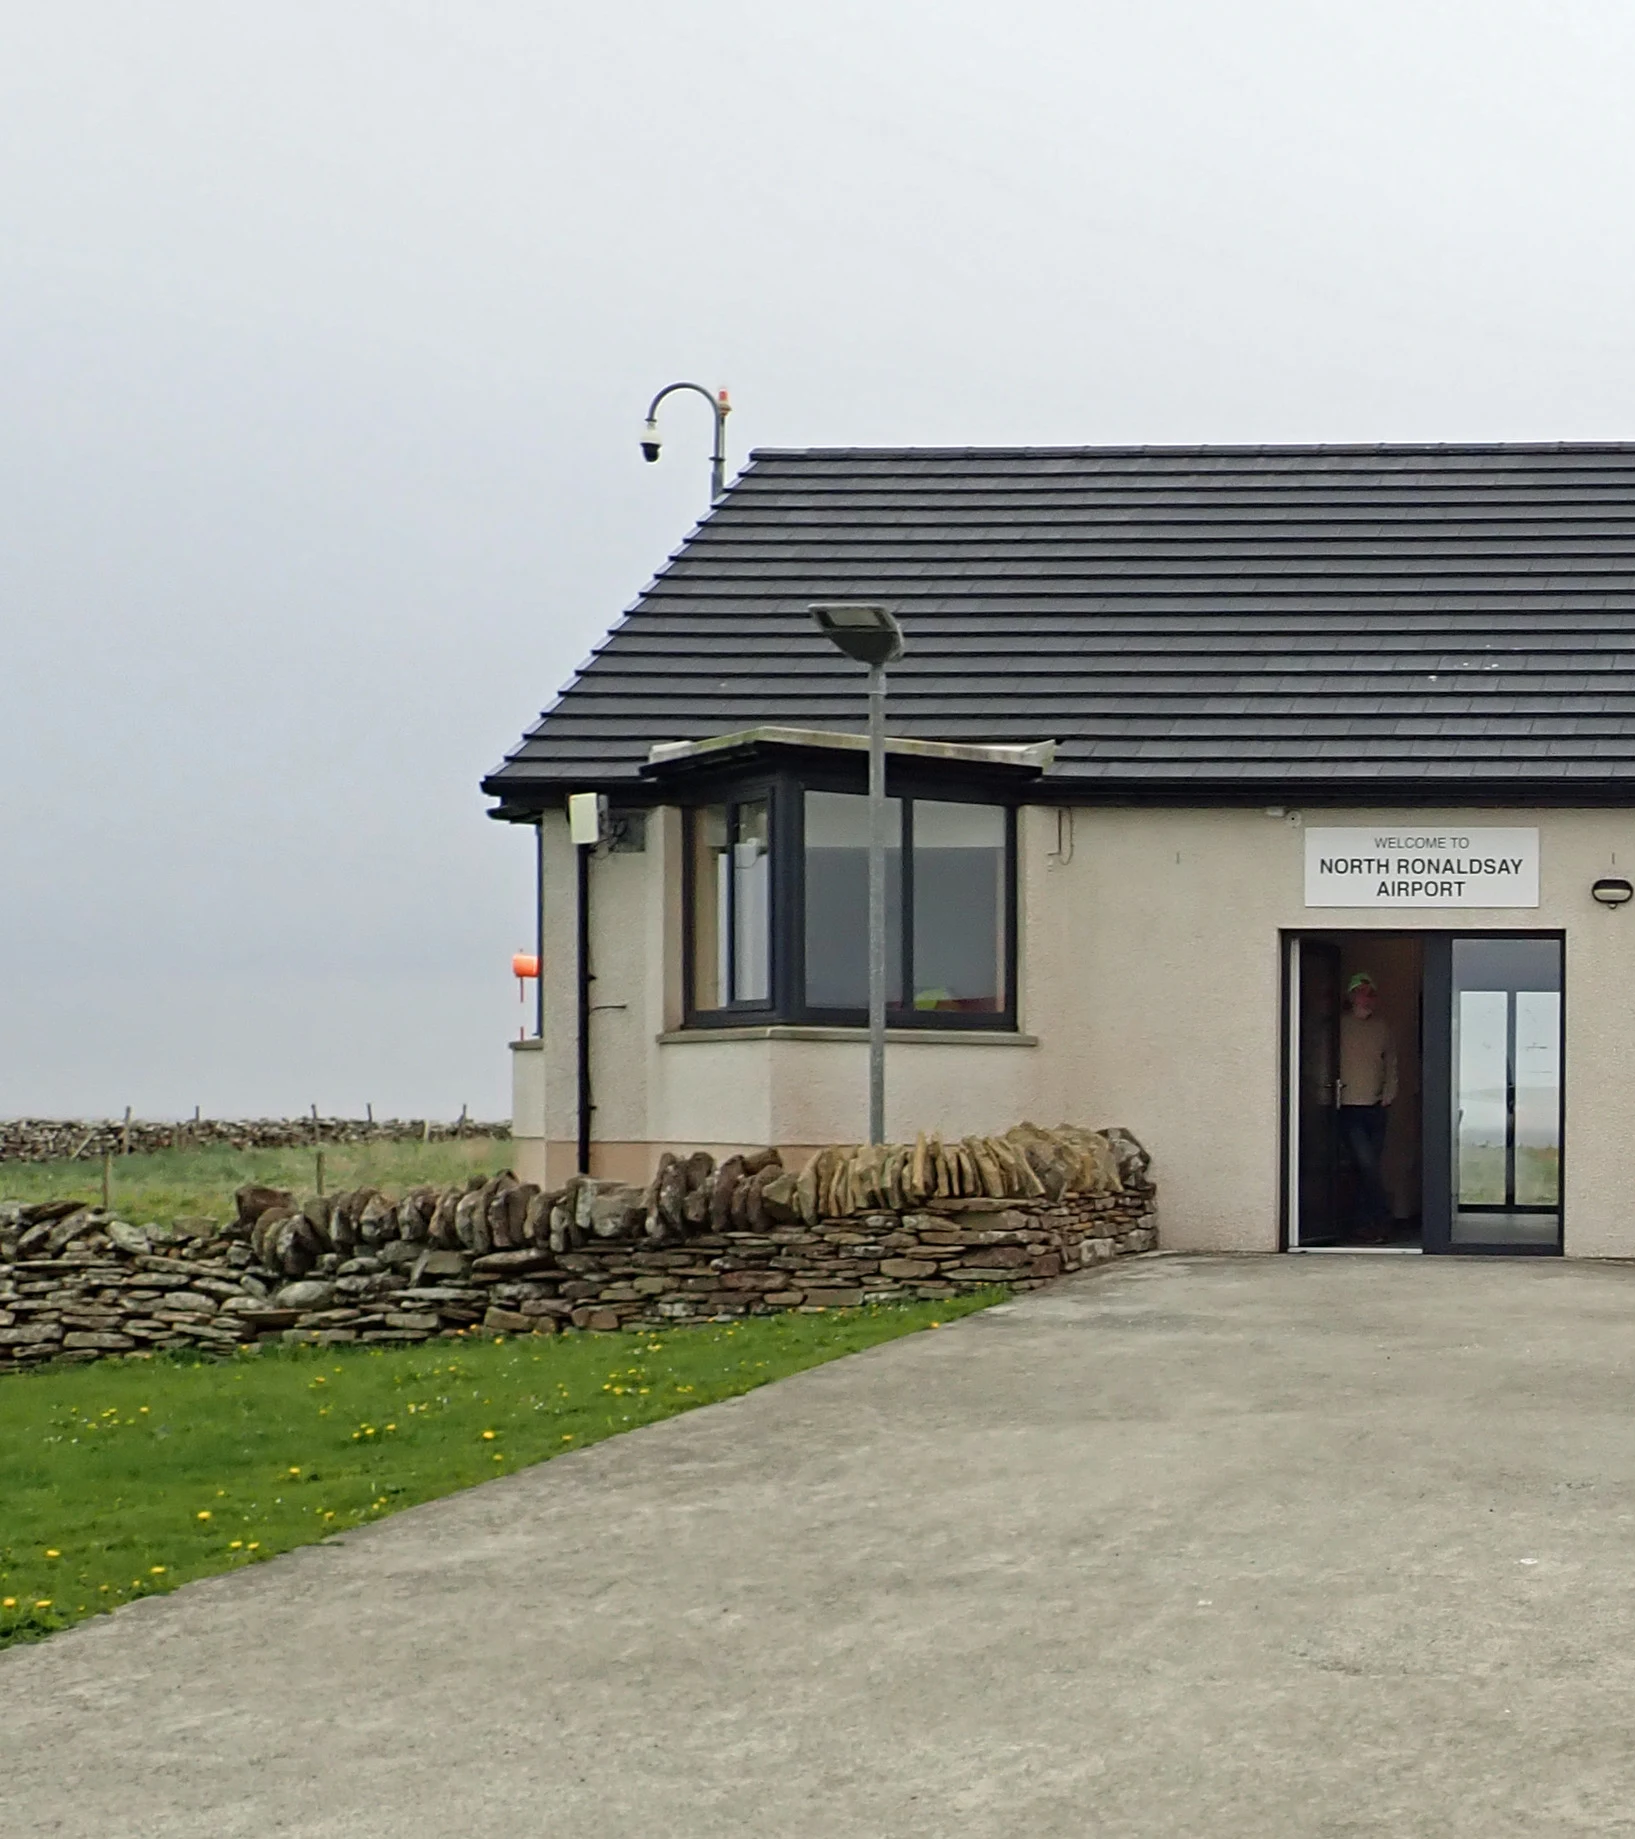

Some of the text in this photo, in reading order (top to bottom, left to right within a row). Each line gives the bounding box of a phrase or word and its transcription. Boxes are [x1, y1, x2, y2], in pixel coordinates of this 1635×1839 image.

[1374, 837, 1469, 849] WELCOME TO
[1320, 858, 1523, 874] NORTH RONALDSAY
[1376, 881, 1466, 897] AIRPORT
